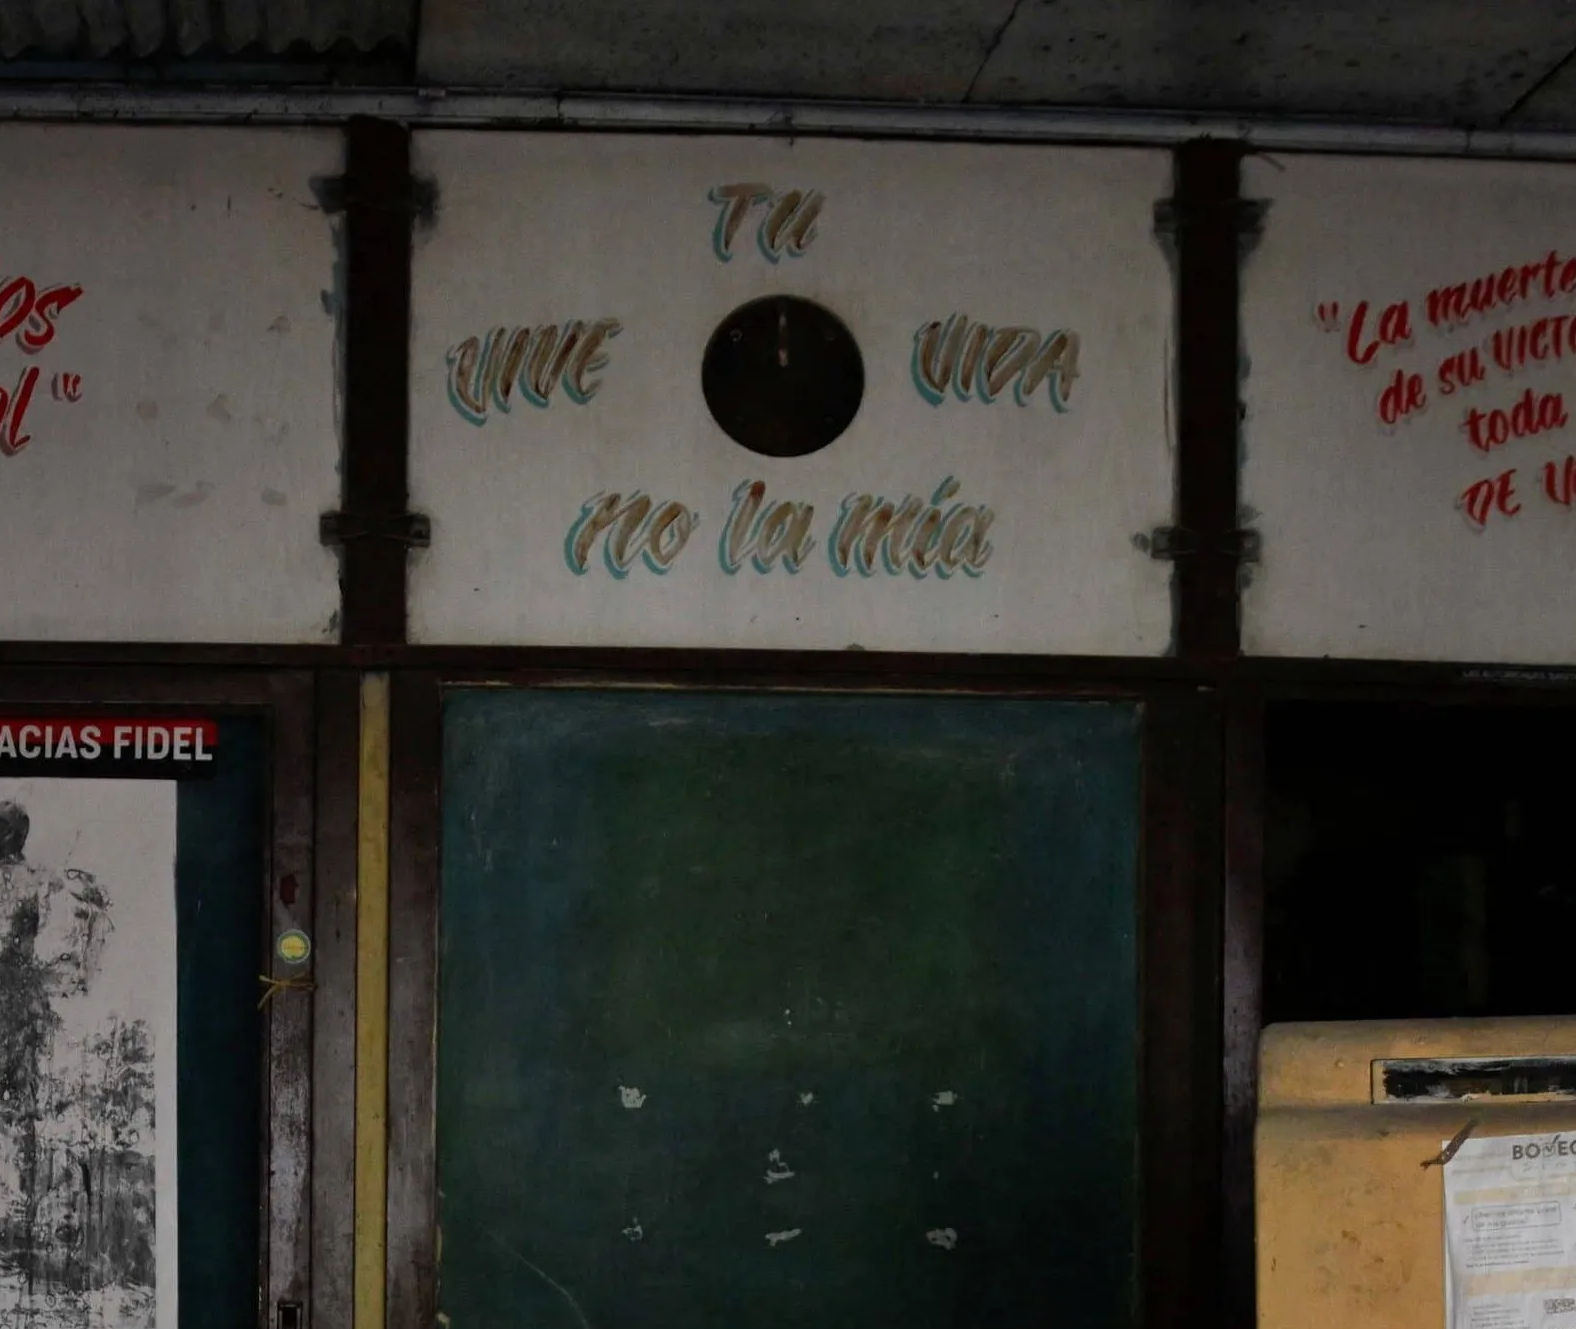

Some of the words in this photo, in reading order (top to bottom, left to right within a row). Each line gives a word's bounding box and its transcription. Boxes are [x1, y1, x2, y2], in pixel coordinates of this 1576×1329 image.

[445, 317, 624, 427] VIVE
[912, 312, 1081, 414] VIDA
[1380, 368, 1428, 427] de
[1437, 344, 1487, 397] su
[1462, 387, 1569, 454] toda
[717, 479, 819, 576] la
[827, 474, 998, 580] mía
[1462, 468, 1523, 529] DE
[112, 726, 215, 762] FIDEL
